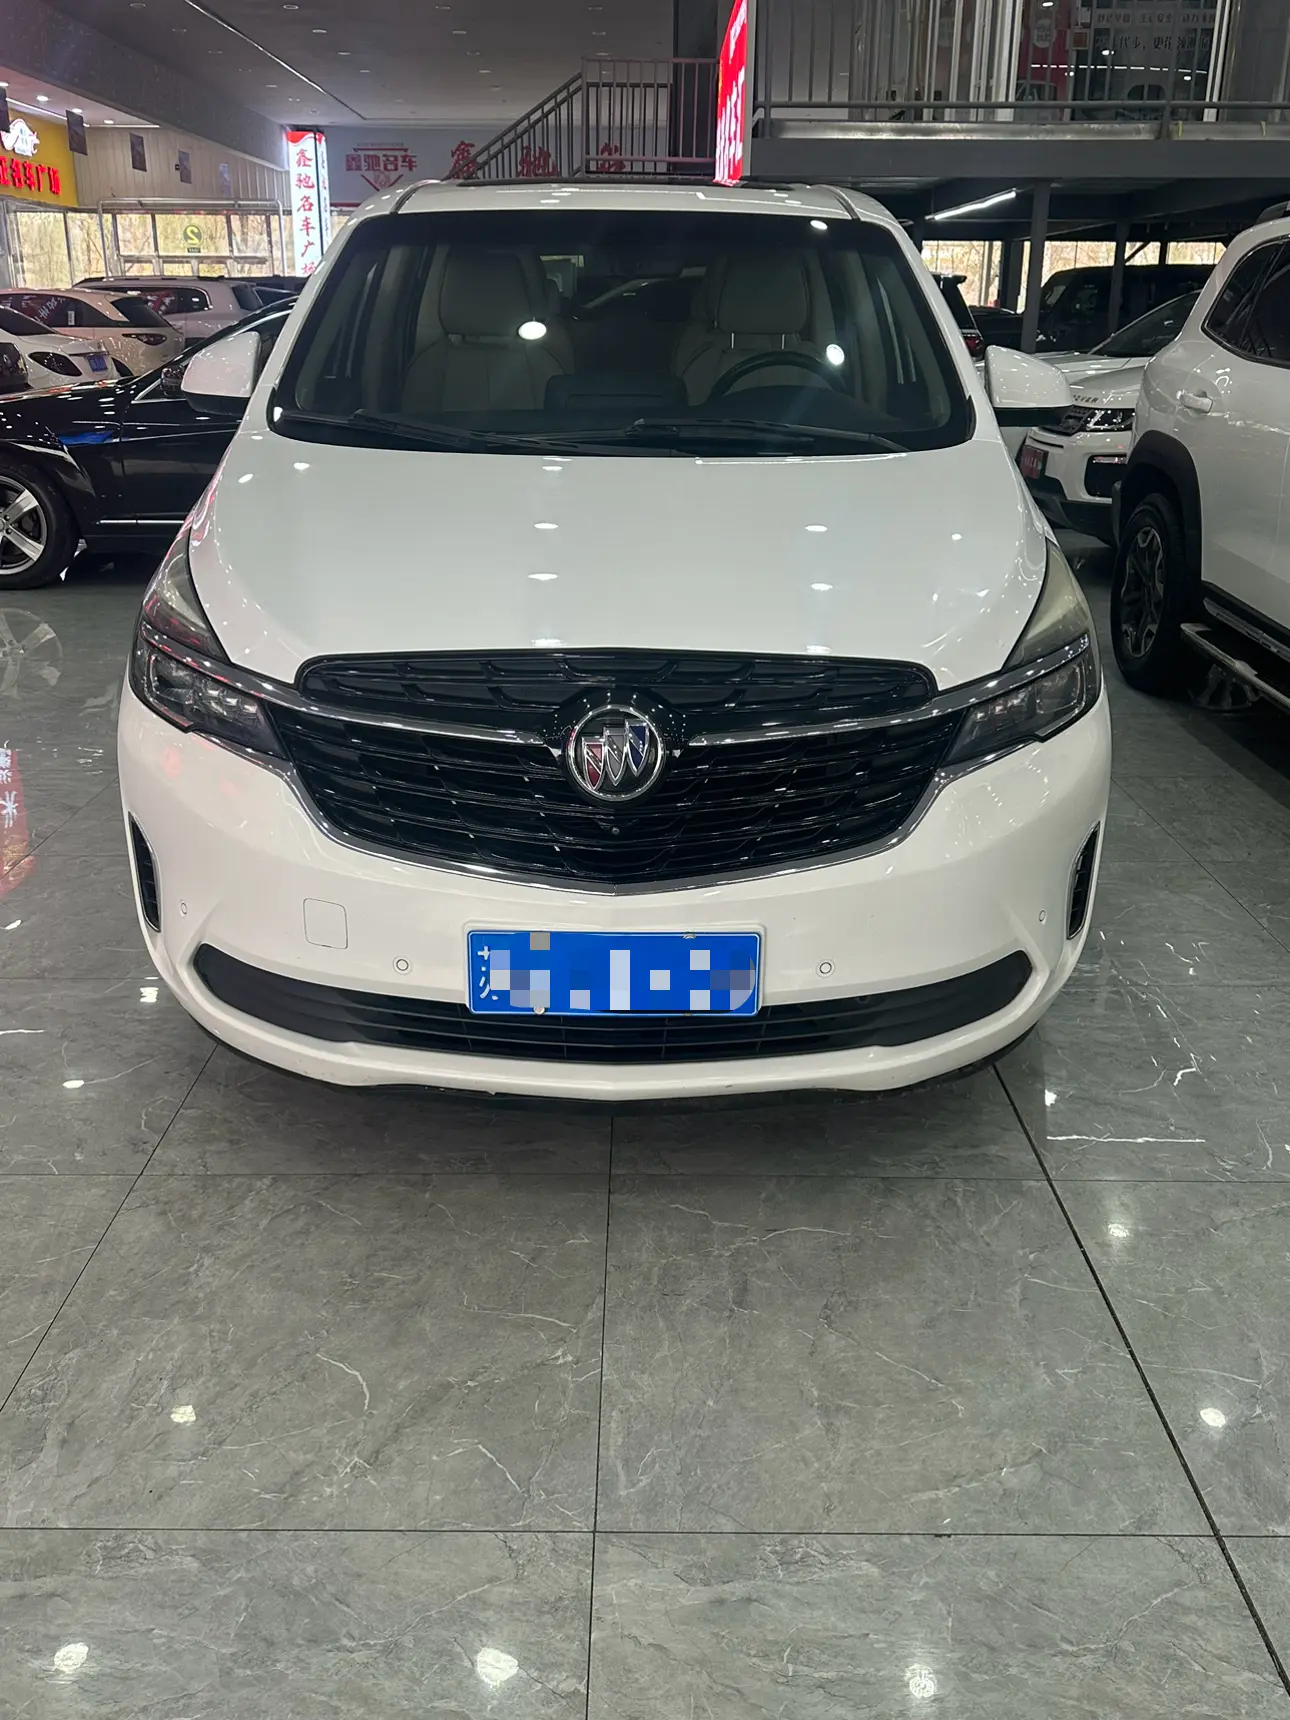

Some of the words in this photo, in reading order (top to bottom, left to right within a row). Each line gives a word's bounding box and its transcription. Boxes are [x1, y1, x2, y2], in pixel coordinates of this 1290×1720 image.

[295, 148, 316, 276] 鑫驰名车广场
